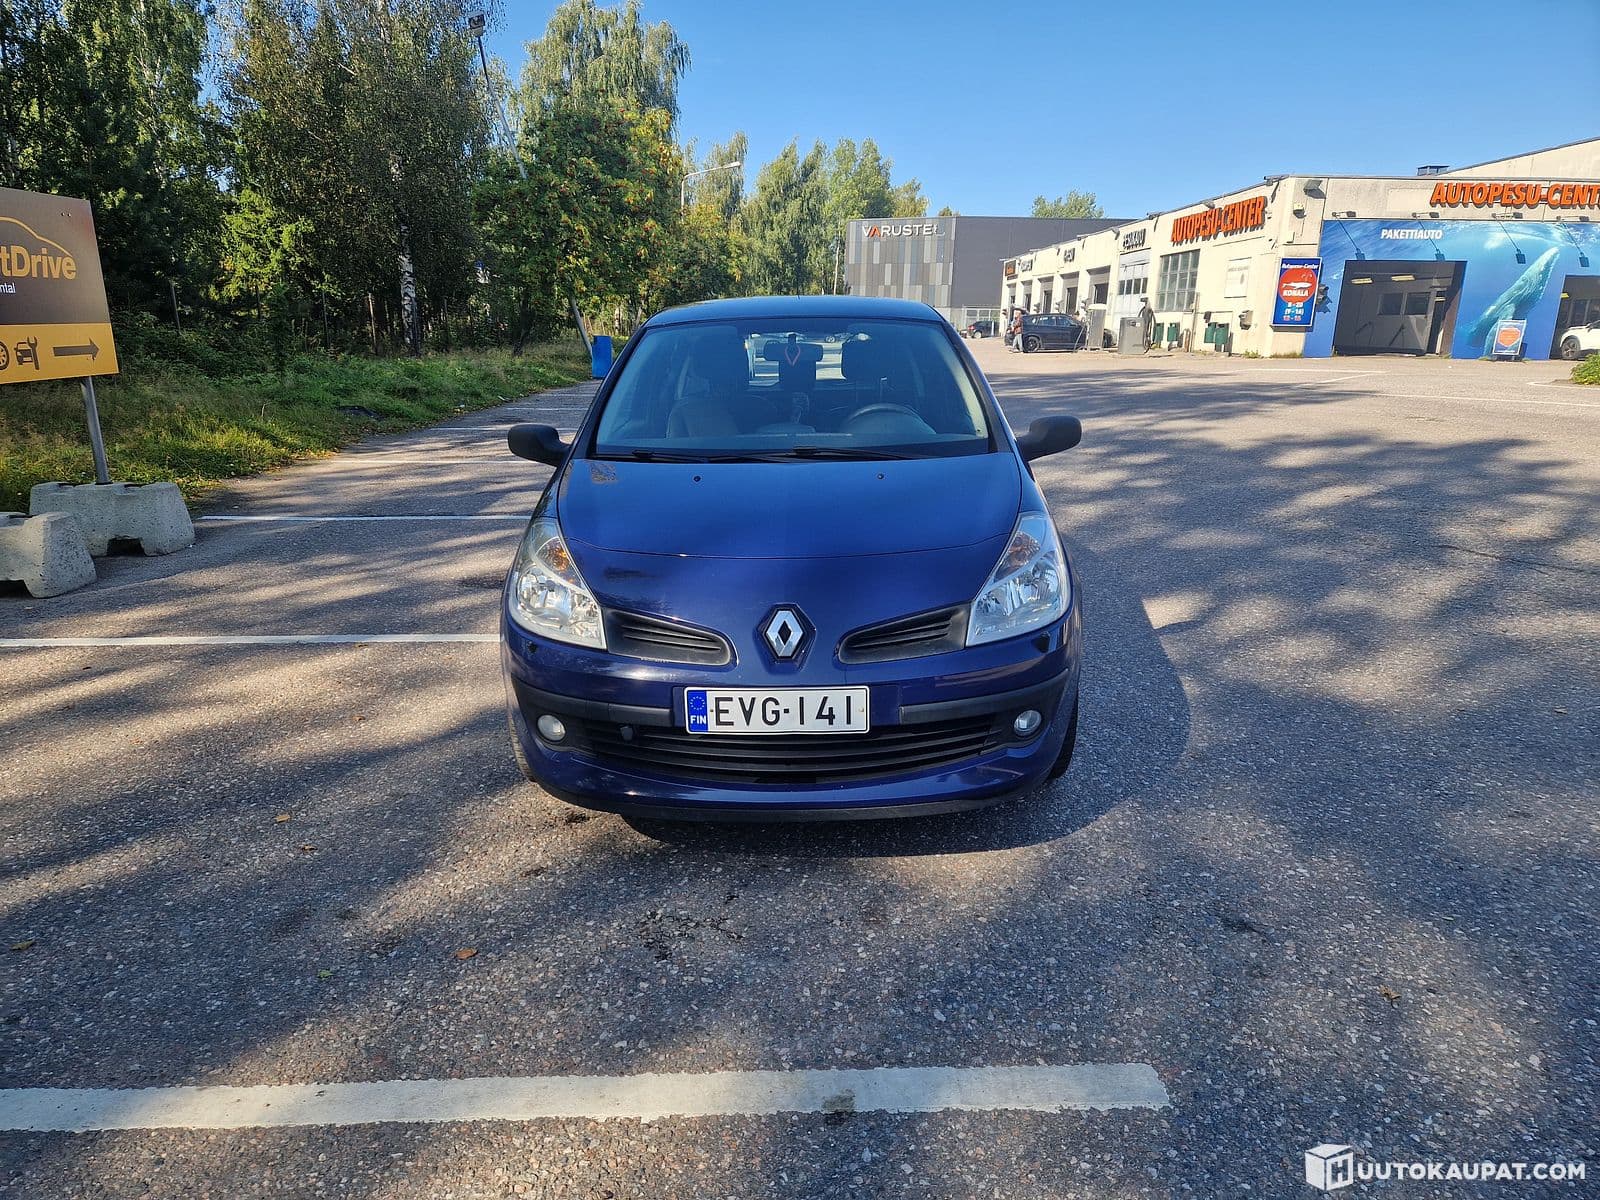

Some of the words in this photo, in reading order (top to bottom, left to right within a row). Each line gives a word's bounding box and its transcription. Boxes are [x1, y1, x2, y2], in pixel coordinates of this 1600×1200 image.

[1171, 196, 1266, 243] AUTOPESU-CENTER
[1381, 229, 1443, 240] PAKETTIAUTO
[690, 715, 707, 725] FIN
[714, 695, 852, 727] EVG-141
